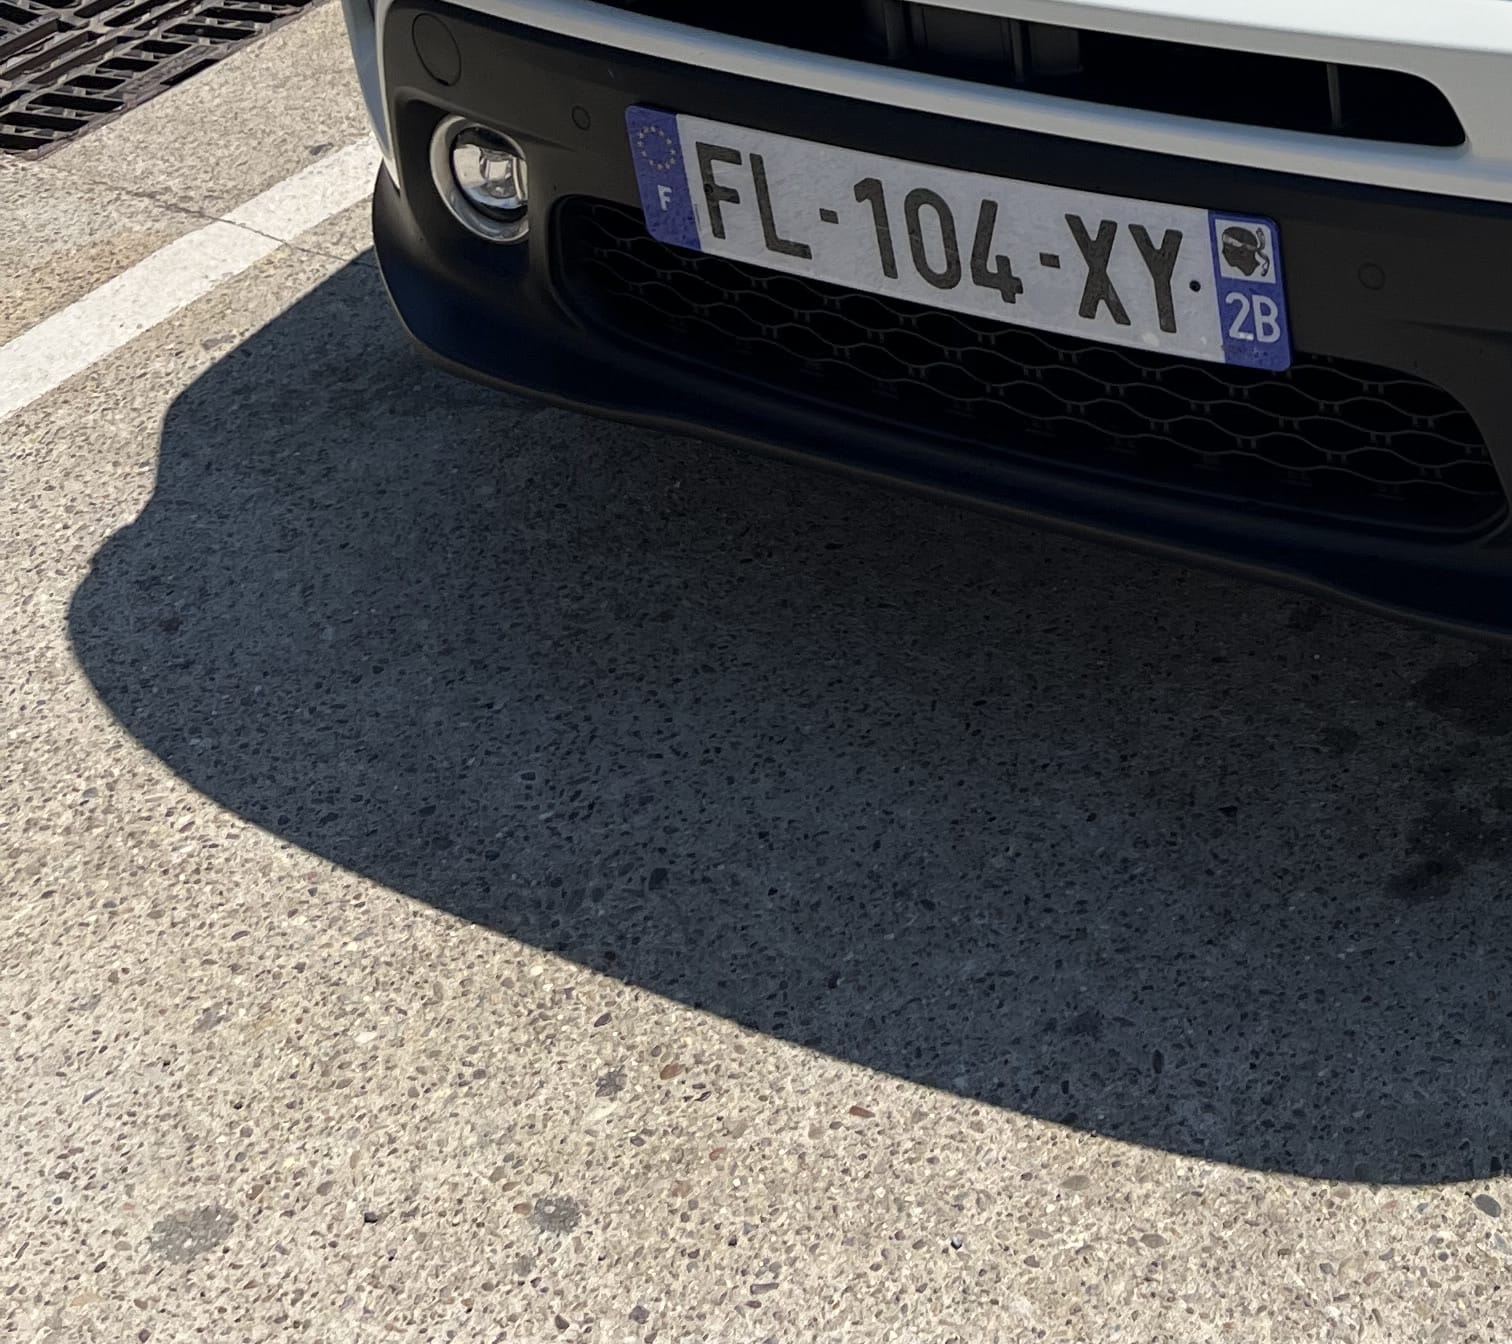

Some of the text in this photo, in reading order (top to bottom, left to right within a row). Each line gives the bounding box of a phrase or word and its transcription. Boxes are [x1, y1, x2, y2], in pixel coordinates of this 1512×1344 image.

[657, 184, 673, 211] F
[695, 141, 1182, 333] FL-104-XY
[1225, 291, 1281, 343] 2B
